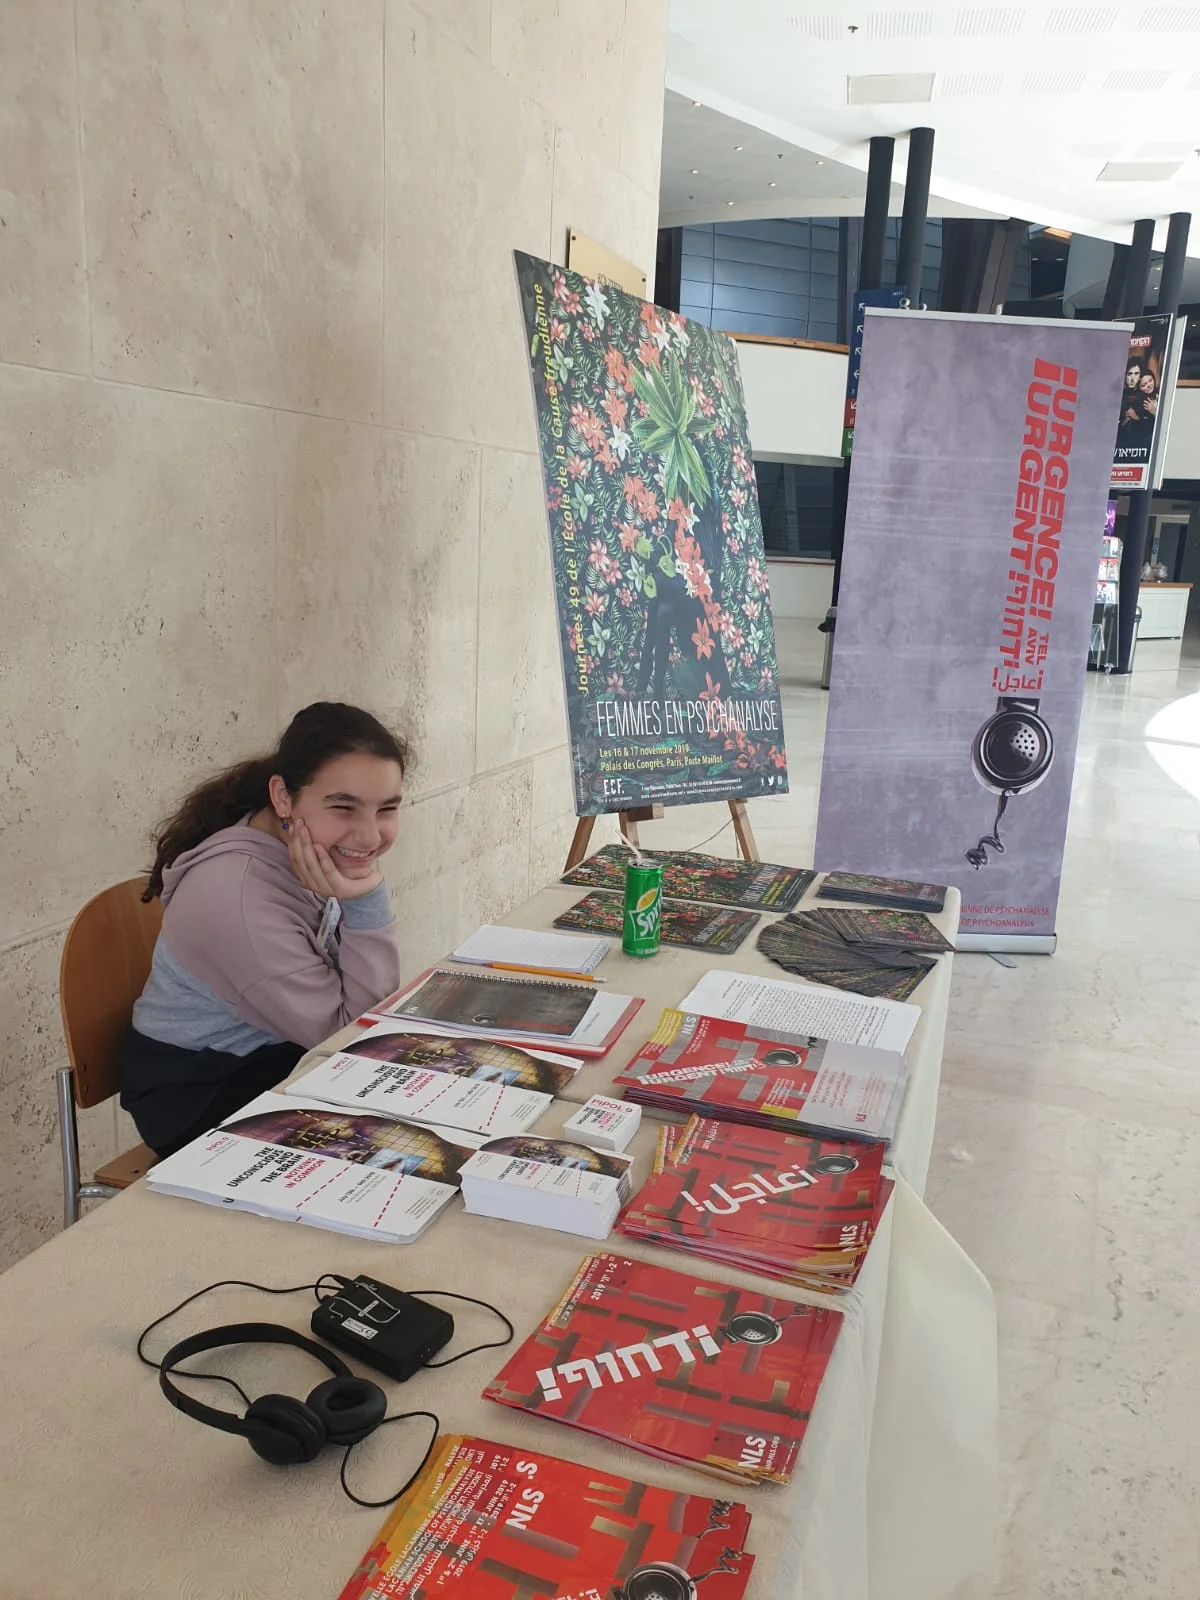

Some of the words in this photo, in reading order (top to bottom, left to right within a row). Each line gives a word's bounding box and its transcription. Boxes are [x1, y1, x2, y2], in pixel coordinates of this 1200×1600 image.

[533, 284, 558, 381] freudienne
[549, 388, 563, 439] Cause
[554, 444, 566, 460] la
[557, 466, 569, 487] de
[560, 494, 575, 552] l'École
[567, 559, 579, 581] de
[568, 588, 581, 607] 49
[574, 613, 590, 697] Journées
[1024, 627, 1039, 665] AVIV
[1035, 632, 1049, 665] TEL
[596, 701, 662, 737] FEMMES
[666, 701, 683, 735] EN
[687, 700, 779, 733] PSYCHANALYSE
[600, 748, 611, 757] Les
[613, 747, 622, 757] 16
[623, 747, 630, 757] &
[630, 746, 639, 756] 17
[640, 745, 673, 756] novembre
[674, 744, 689, 753] 2019
[600, 760, 622, 771] Palais
[623, 760, 636, 770] des
[666, 757, 683, 767] Paris,
[684, 756, 701, 766] Porte
[702, 755, 723, 764] Maillot
[984, 905, 994, 914] DE
[996, 906, 1049, 916] PSYCHANALYSE
[973, 919, 1034, 928] PSYCHOANALYSIS
[681, 1016, 697, 1035] NLS
[374, 1064, 391, 1075] THE
[393, 1068, 408, 1079] AND
[355, 1066, 399, 1098] UNCONSCIOUS
[384, 1085, 397, 1094] THE
[396, 1070, 417, 1086] BRAIN
[402, 1072, 429, 1091] NOTHING
[411, 1073, 437, 1093] COMMON
[592, 1099, 623, 1111] PIPOL
[254, 1146, 274, 1158] THE
[274, 1151, 295, 1164] AND
[227, 1149, 284, 1187] UNCONSCIOUS
[260, 1171, 282, 1183] THE
[279, 1154, 305, 1172] BRAIN
[284, 1157, 316, 1179] NOTHING
[293, 1159, 326, 1185] COMMON
[839, 1225, 858, 1246] NLS
[605, 1263, 617, 1273] 1-2
[591, 1284, 606, 1300] 2019
[738, 1436, 767, 1469] NLS
[505, 1482, 518, 1493] 1-2
[400, 1518, 432, 1561] LACANIENNE
[429, 1508, 438, 1519] DE
[435, 1466, 468, 1510] PSYCHANALYSE
[453, 1538, 472, 1557] JUNE
[474, 1517, 486, 1525] ET
[483, 1495, 500, 1511] JUIN
[493, 1479, 510, 1496] 2019
[488, 1502, 506, 1519] 2019
[505, 1488, 544, 1530] NLS
[385, 1555, 415, 1593] LACANIAN
[412, 1529, 435, 1556] SCHOOL
[431, 1517, 441, 1528] OF
[439, 1469, 477, 1519] PSYCHOANALYSIS
[475, 1528, 489, 1539] 1-2
[451, 1558, 470, 1577] 2019
